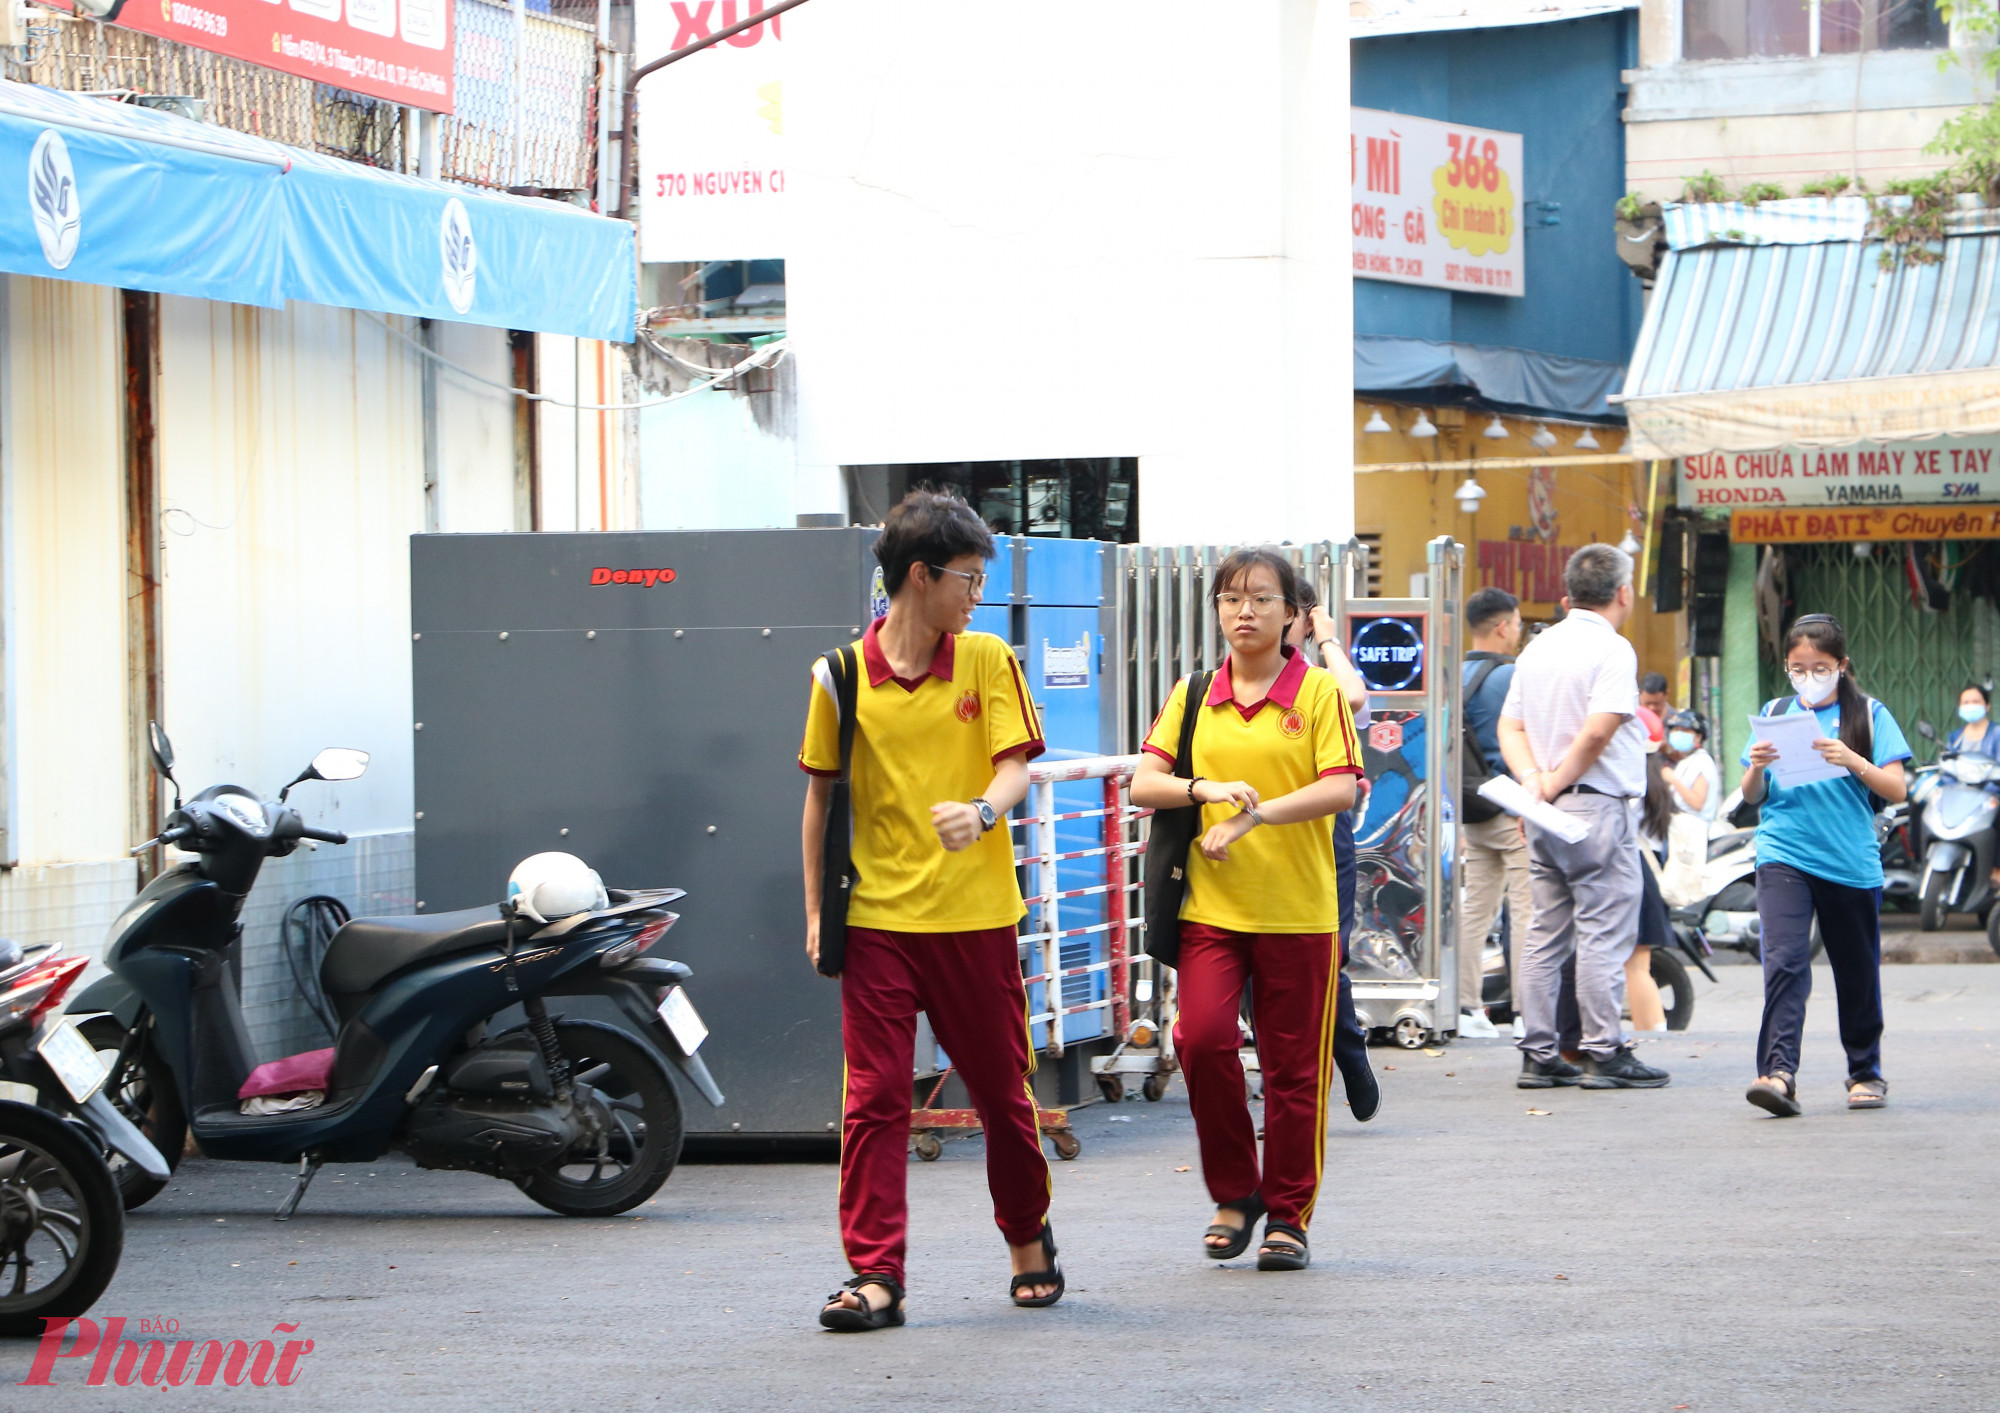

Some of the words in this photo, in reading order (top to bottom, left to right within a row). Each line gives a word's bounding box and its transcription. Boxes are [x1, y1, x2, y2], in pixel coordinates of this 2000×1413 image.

[1366, 129, 1401, 195] MÌ
[1447, 132, 1500, 193] 368
[657, 173, 687, 197] 370
[1858, 444, 1905, 476] MÁY
[1914, 450, 1941, 475] XE
[1950, 449, 1992, 474] TAY
[1697, 487, 1787, 504] HONDA
[1825, 483, 1902, 501] YAMAHA
[1942, 482, 1980, 498] SYM
[1738, 510, 1799, 537] PHÁT
[1892, 511, 1983, 539] Chuyên
[590, 567, 676, 588] Denyo
[1359, 646, 1390, 663] SAFE
[1390, 646, 1417, 663] TRIP
